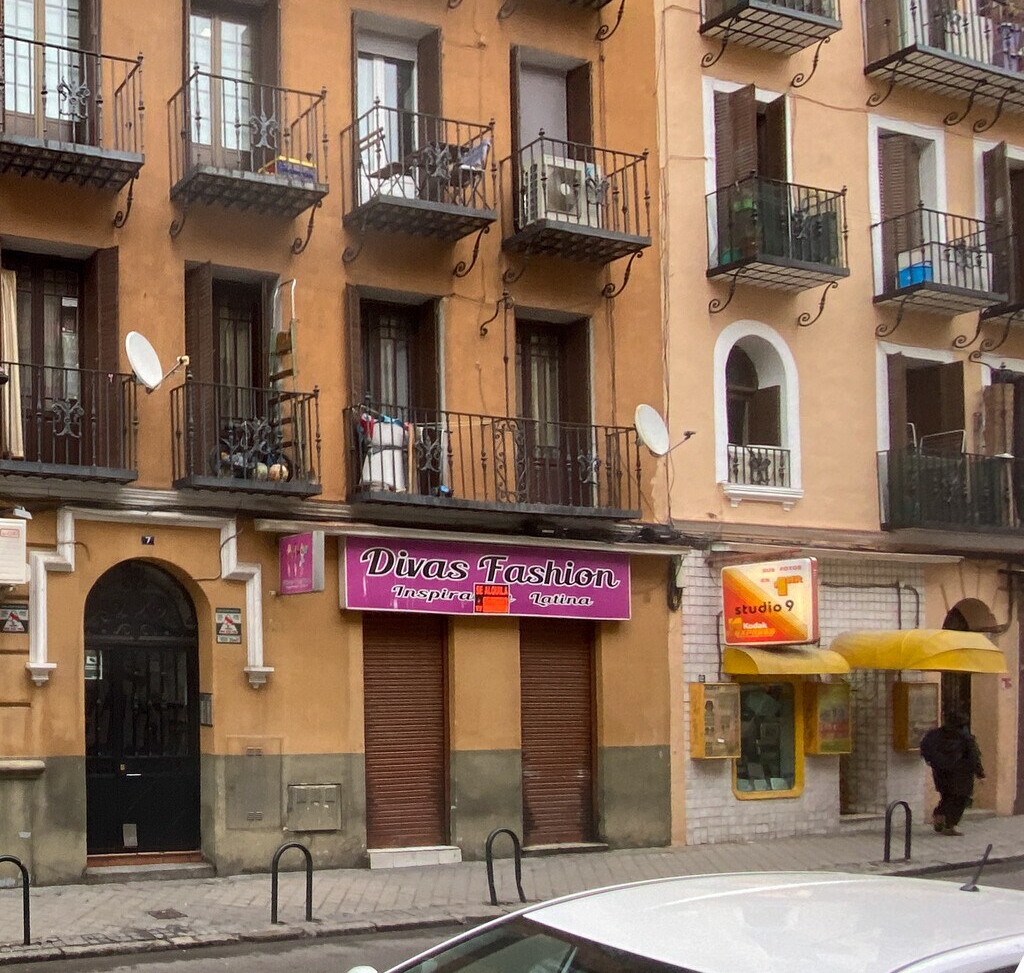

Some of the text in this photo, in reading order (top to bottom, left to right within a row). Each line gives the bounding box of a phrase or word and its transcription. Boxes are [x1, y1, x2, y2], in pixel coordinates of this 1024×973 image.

[361, 546, 621, 588] Divas Fashion
[529, 591, 594, 607] Latina
[735, 599, 794, 615] studio 9
[742, 621, 768, 630] Kodak
